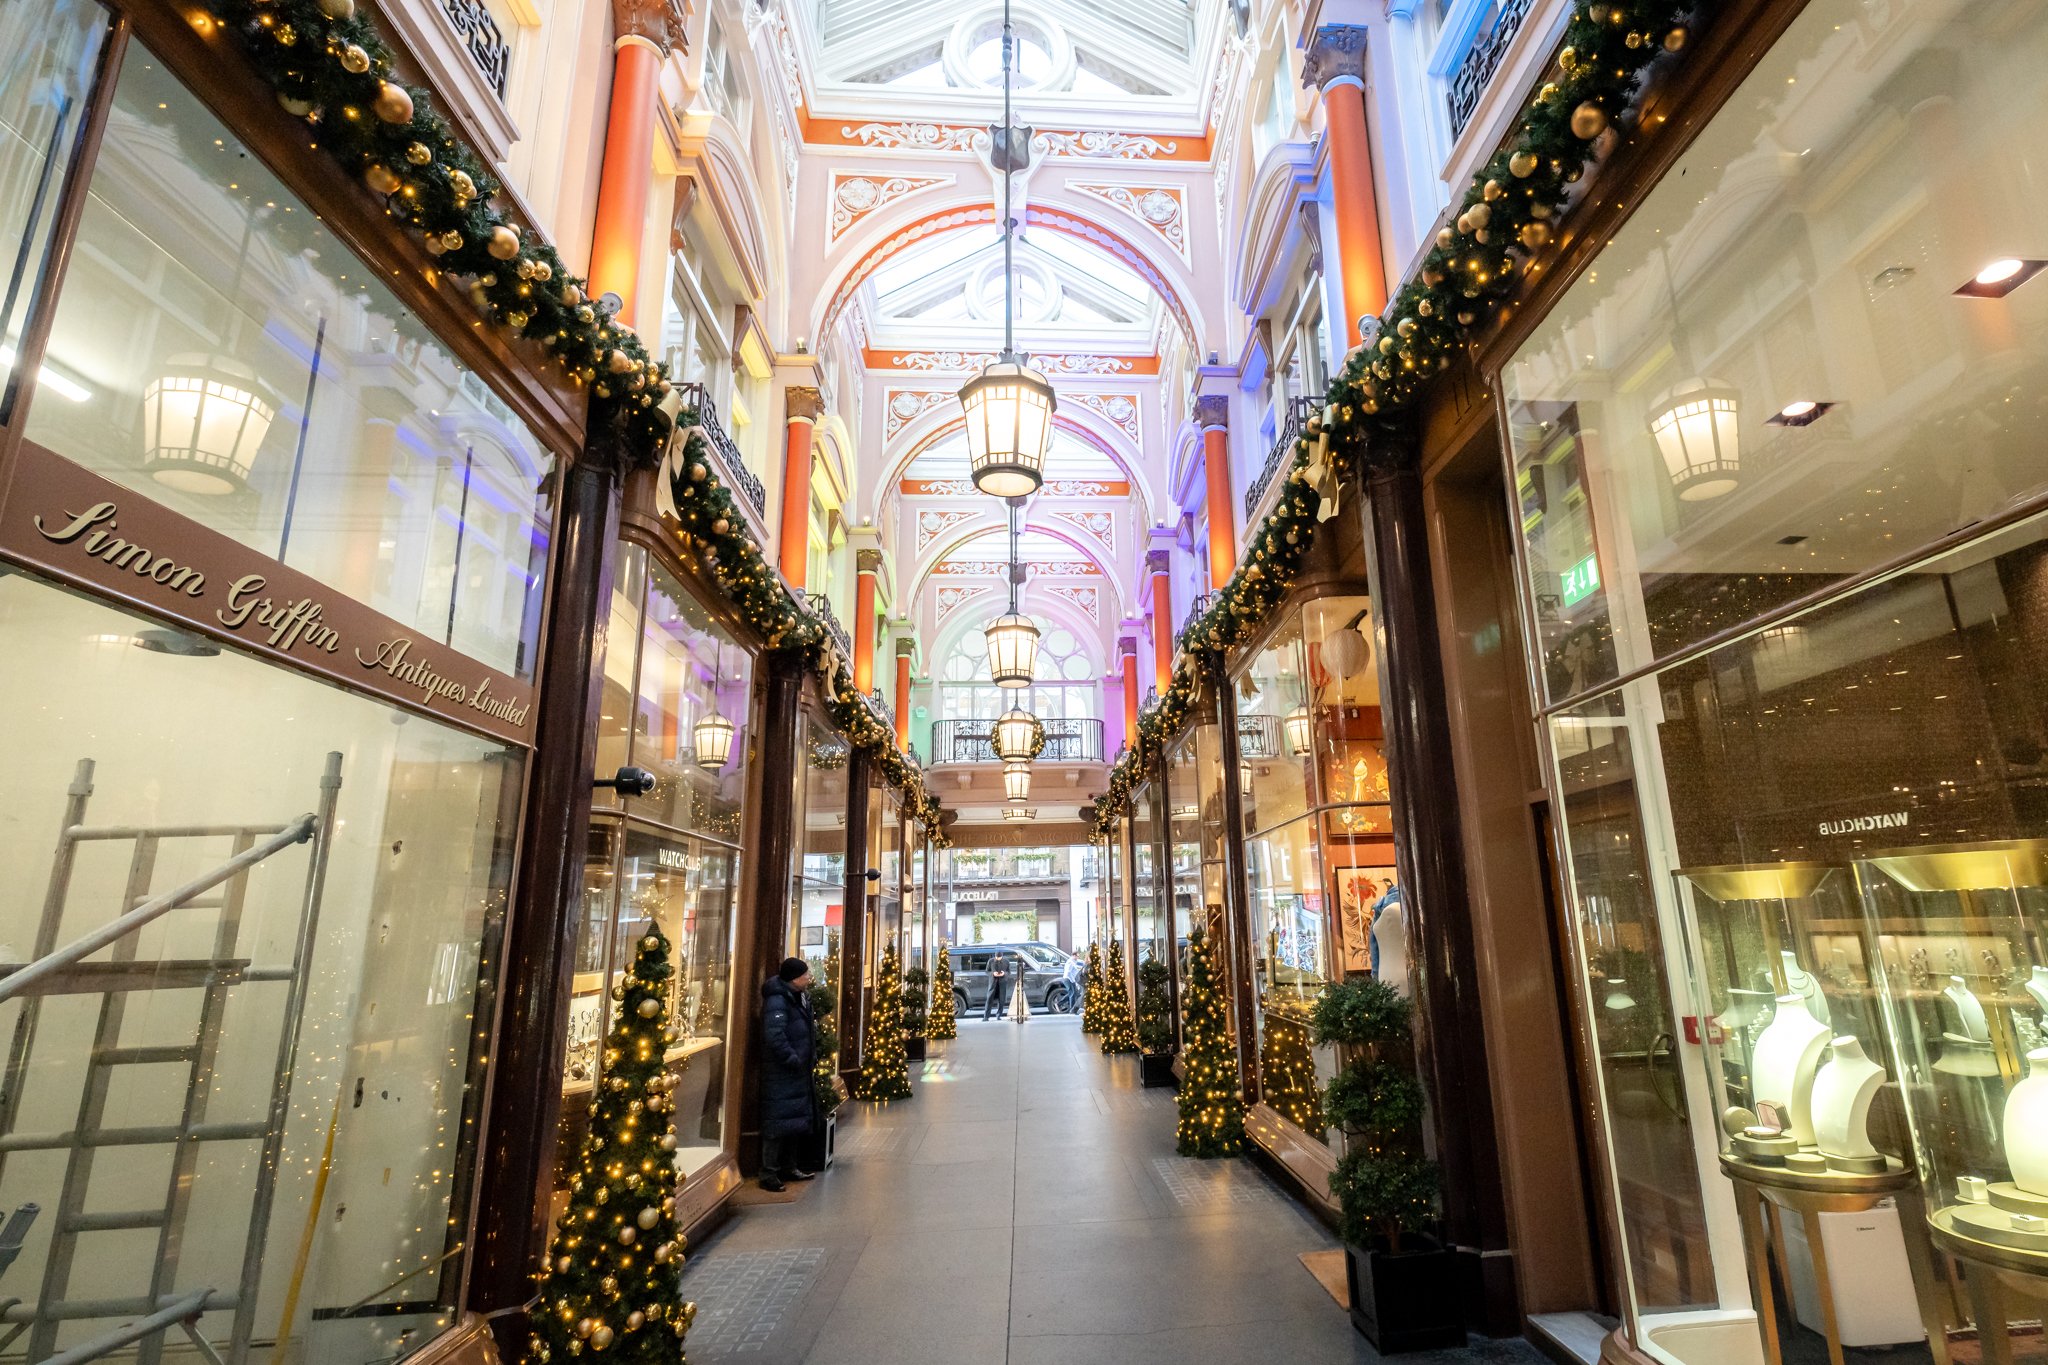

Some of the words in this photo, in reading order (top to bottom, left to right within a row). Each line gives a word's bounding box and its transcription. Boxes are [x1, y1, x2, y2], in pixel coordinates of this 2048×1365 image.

[34, 502, 205, 595] Simon
[216, 574, 339, 652] Griffin
[355, 638, 466, 704] Antiques
[468, 677, 530, 727] Limited
[985, 831, 1025, 844] ROYAL
